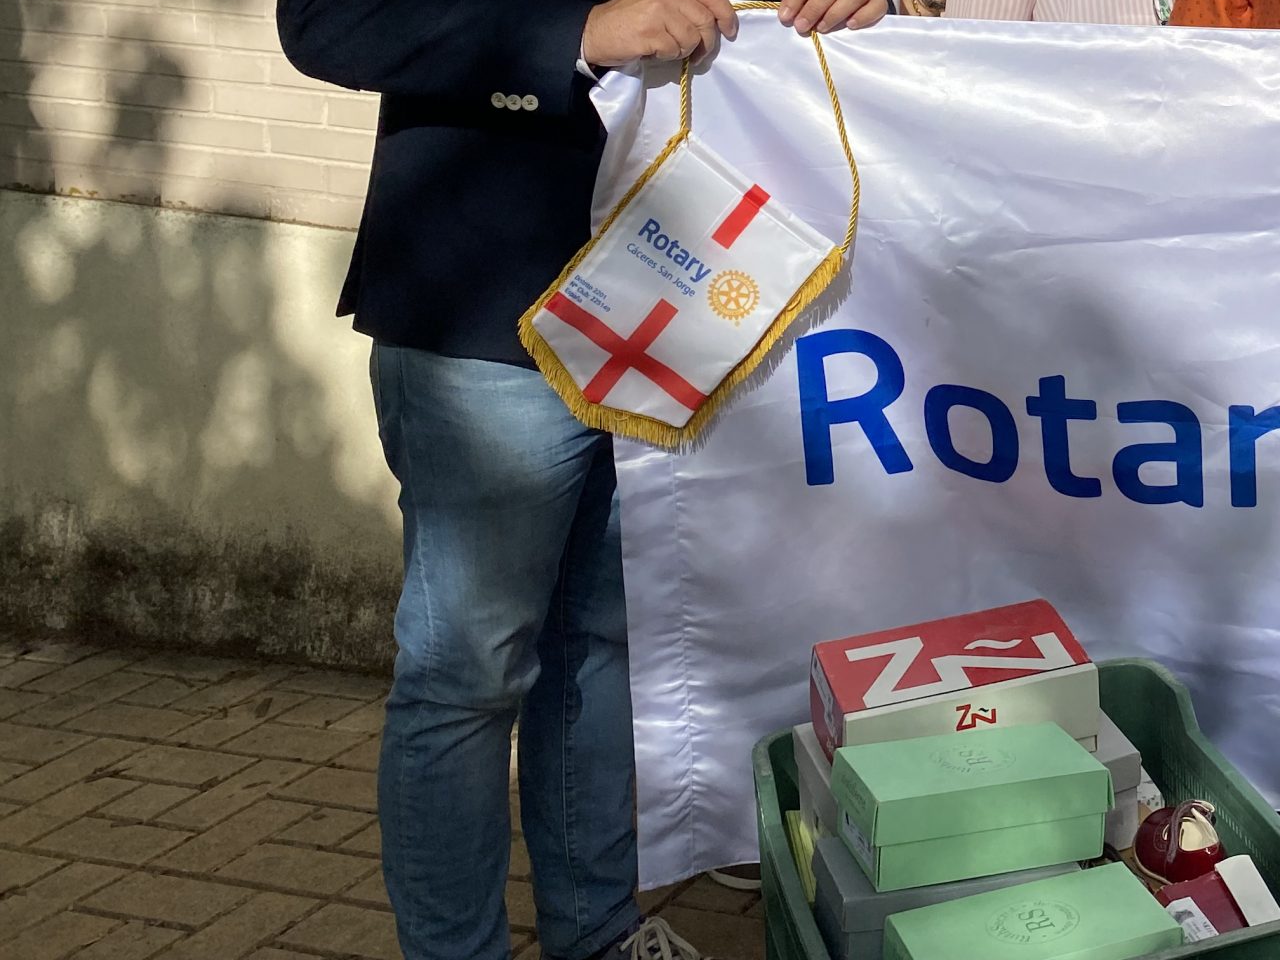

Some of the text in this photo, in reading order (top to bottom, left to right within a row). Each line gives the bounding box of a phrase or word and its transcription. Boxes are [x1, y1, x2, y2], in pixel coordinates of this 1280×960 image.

[626, 242, 659, 270] Cáceres
[656, 263, 674, 282] San
[672, 276, 696, 298] Jorge
[637, 218, 712, 283] Rotary
